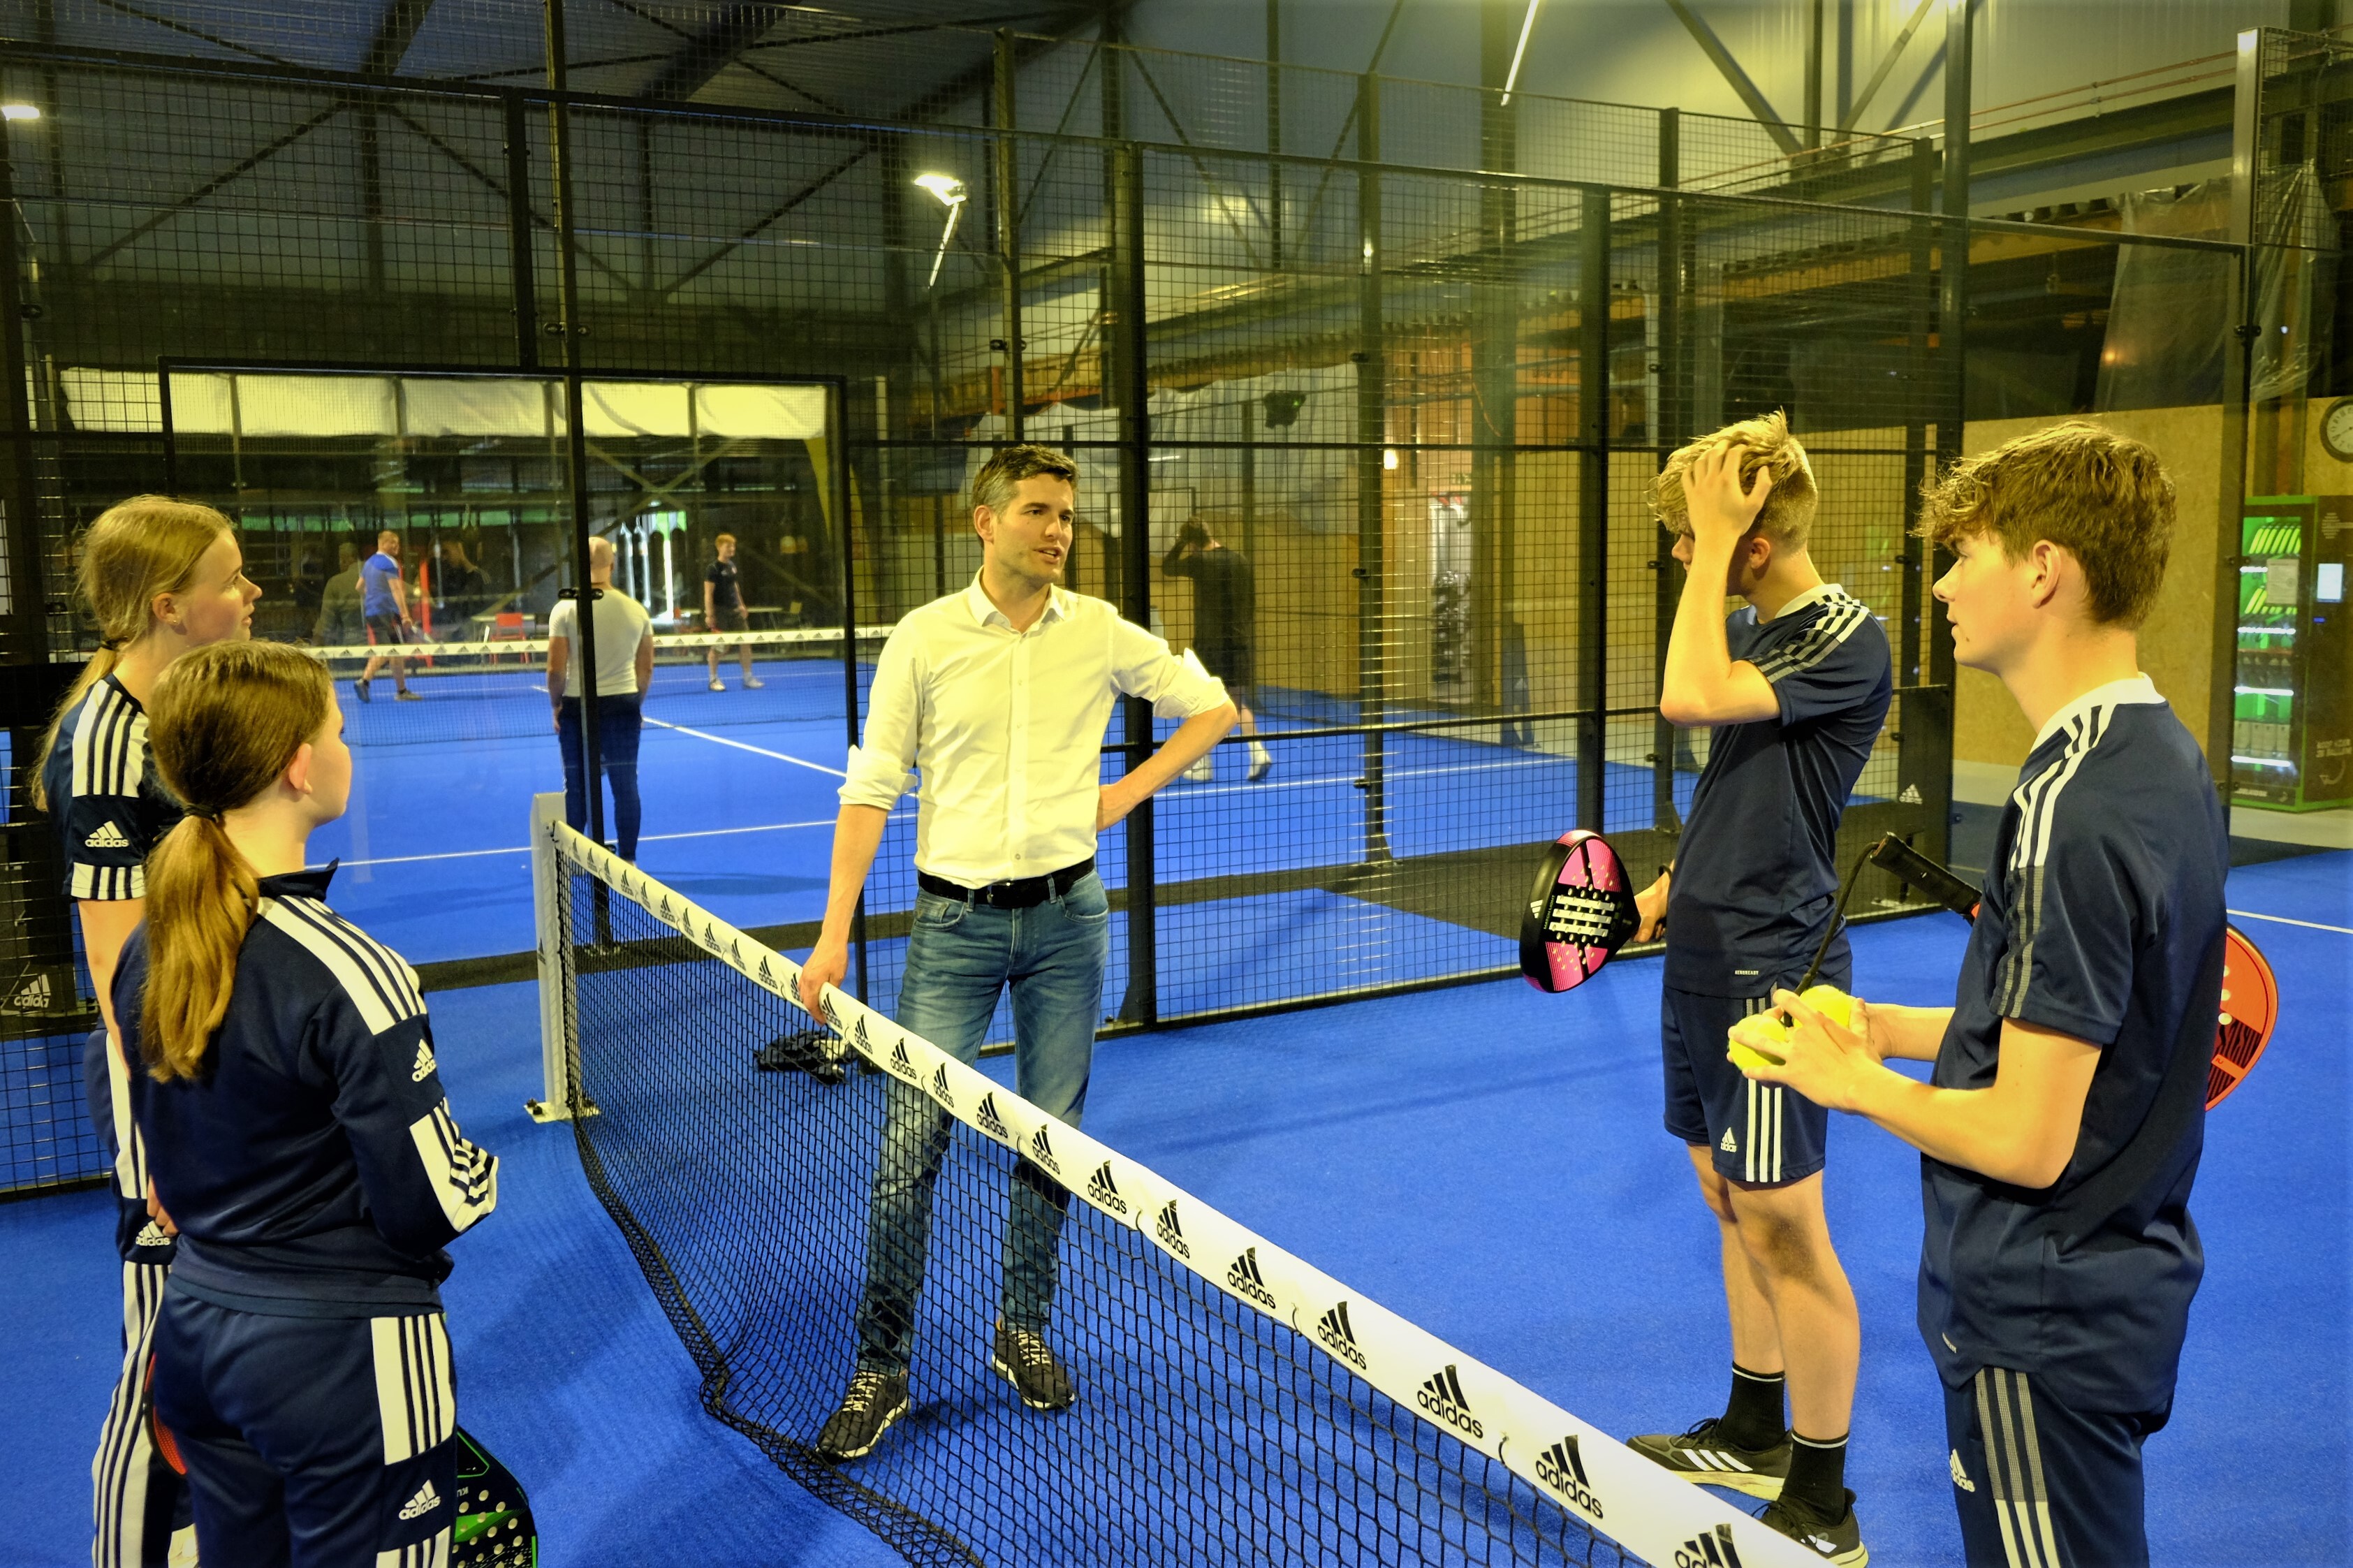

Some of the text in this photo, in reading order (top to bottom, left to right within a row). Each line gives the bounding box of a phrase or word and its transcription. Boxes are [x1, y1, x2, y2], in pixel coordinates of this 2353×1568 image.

[85, 838, 129, 847] adidas
[14, 995, 50, 1008] adida
[855, 1033, 873, 1055] adidas
[890, 1057, 917, 1080] adidas
[933, 1083, 954, 1108] adidas
[977, 1113, 1008, 1138] adidas
[1032, 1145, 1060, 1175] adidas
[1087, 1182, 1127, 1215] adidas
[1157, 1222, 1190, 1259] adidas
[1227, 1271, 1276, 1309] adidas
[1317, 1323, 1367, 1370] adidas
[1417, 1389, 1483, 1439] adidas
[1536, 1460, 1604, 1519] adidas
[399, 1496, 441, 1520] adidas
